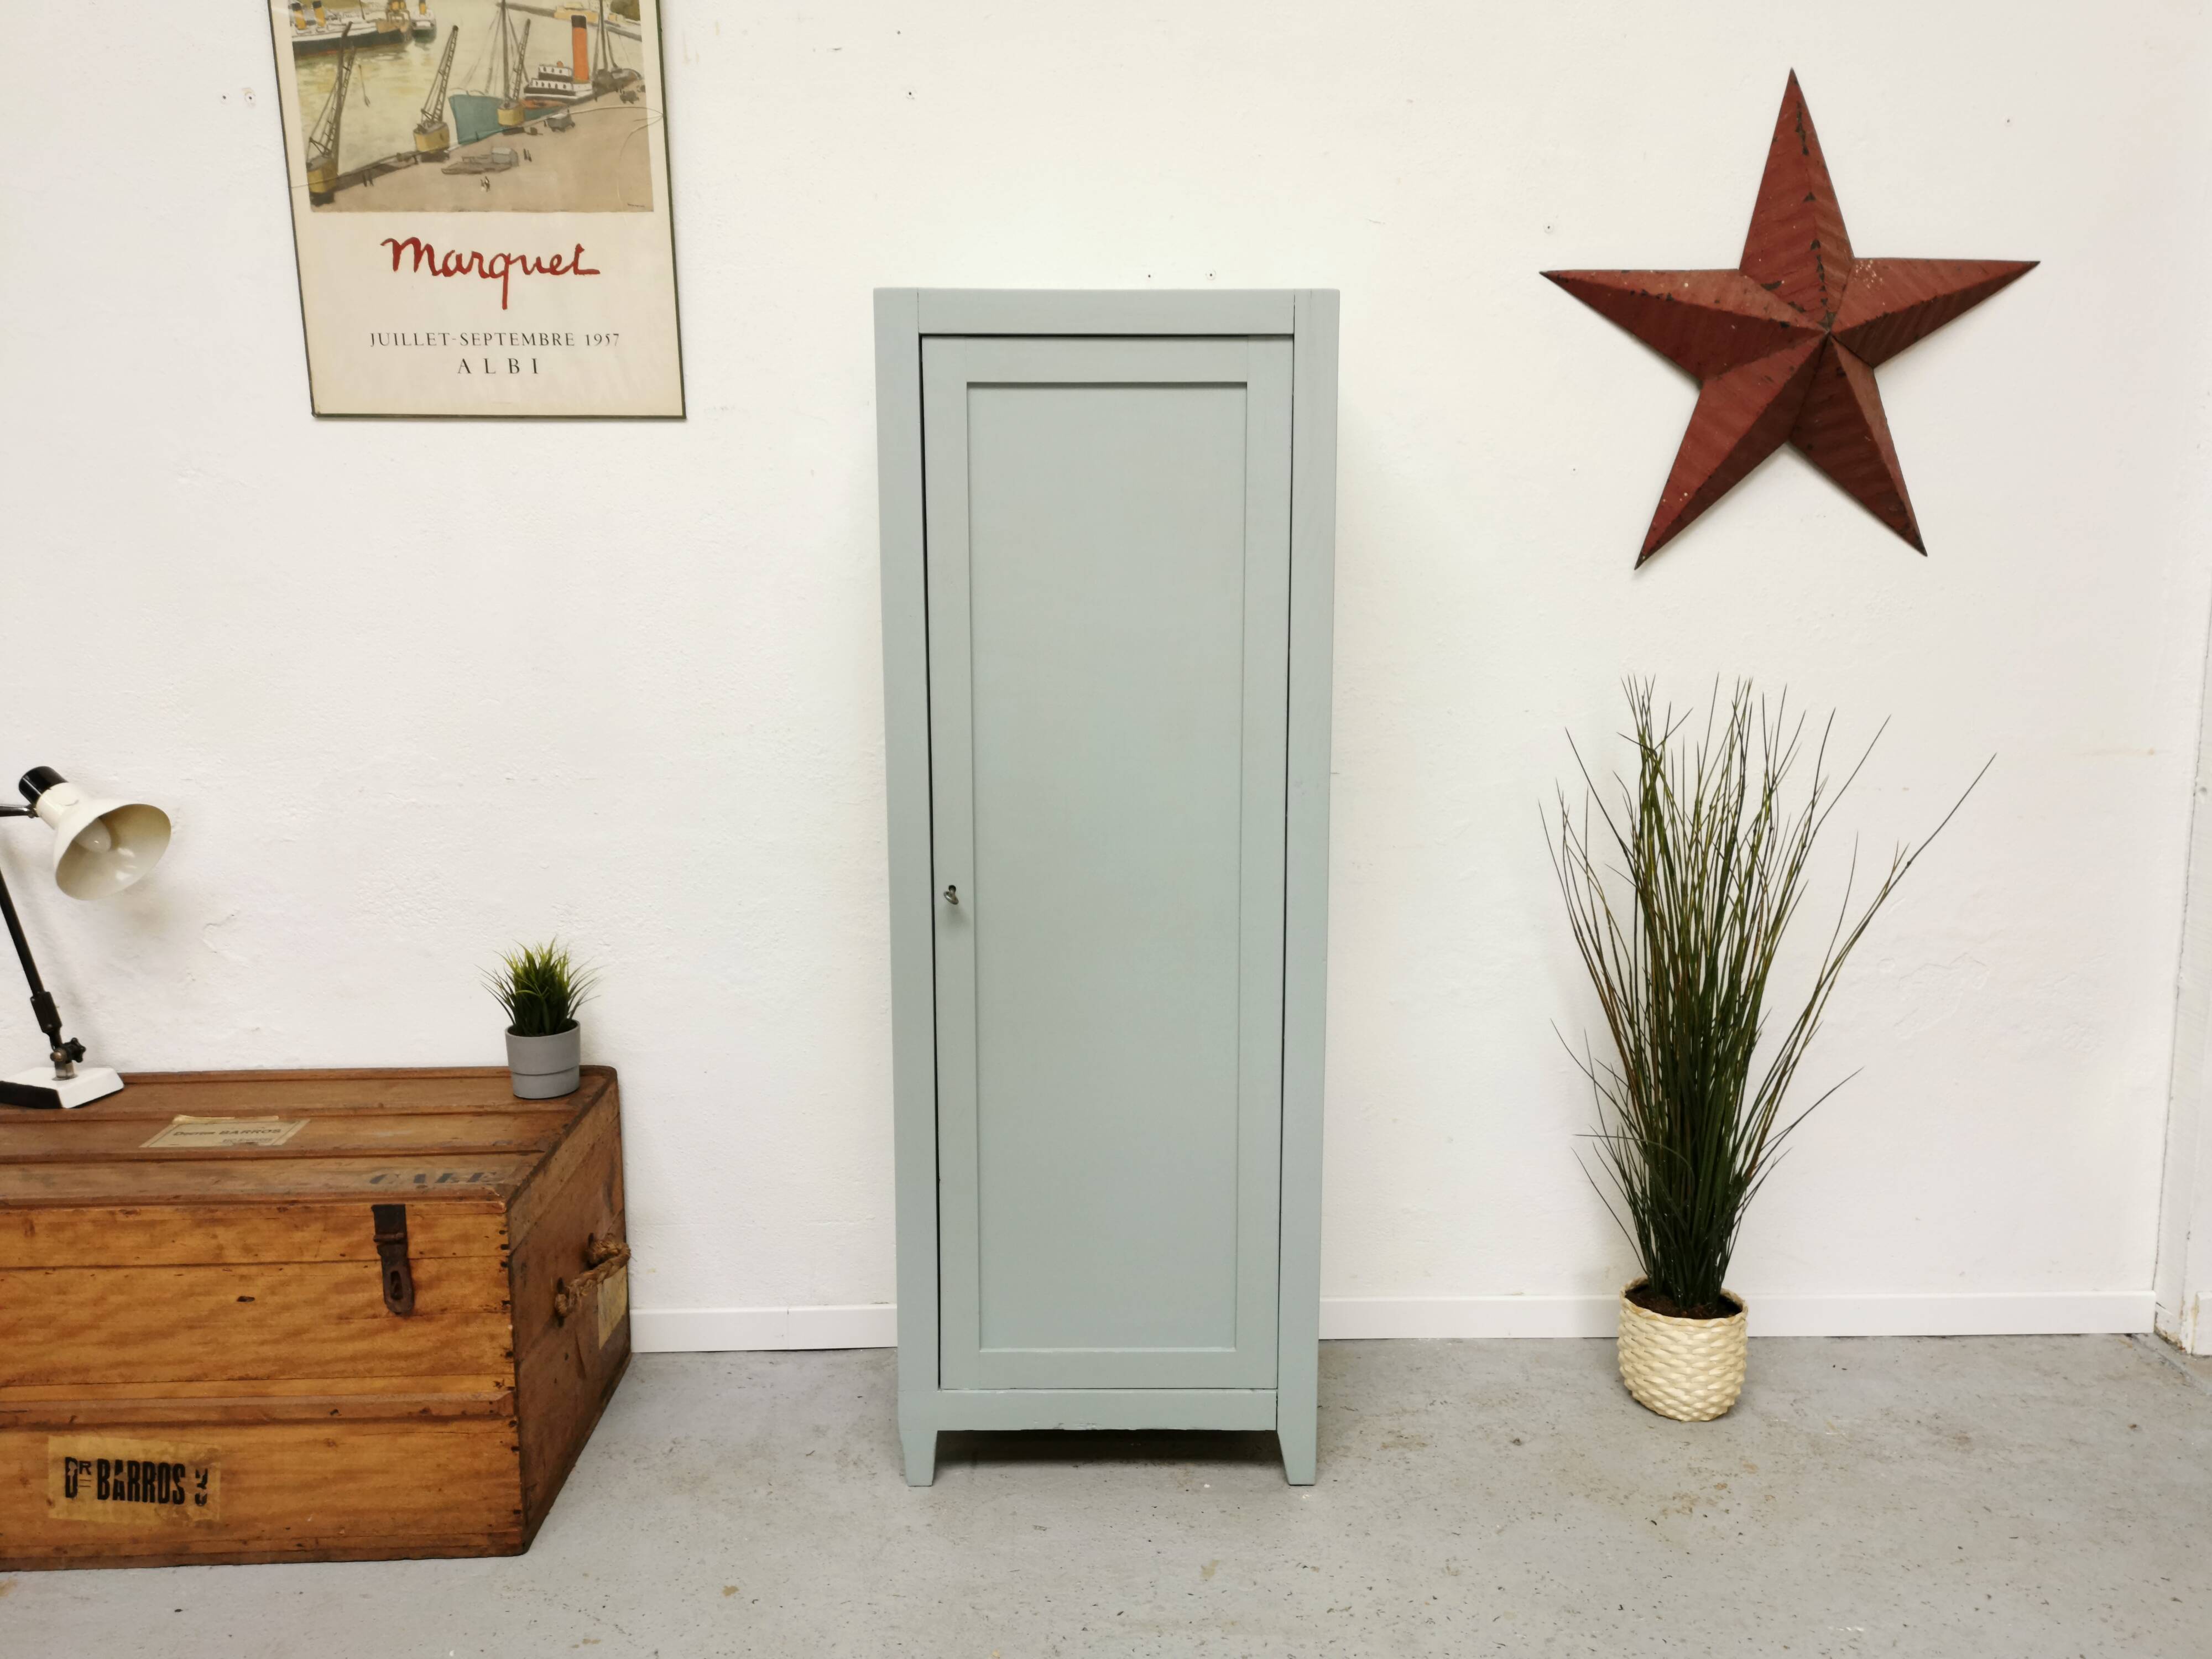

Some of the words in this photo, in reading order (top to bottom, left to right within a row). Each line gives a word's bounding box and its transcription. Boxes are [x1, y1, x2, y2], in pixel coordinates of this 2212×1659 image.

[380, 237, 601, 310] Marquet
[370, 332, 575, 347] JUILLET-SEPTEMBRE
[584, 333, 620, 347] 1957
[97, 1458, 185, 1505] BARROS
